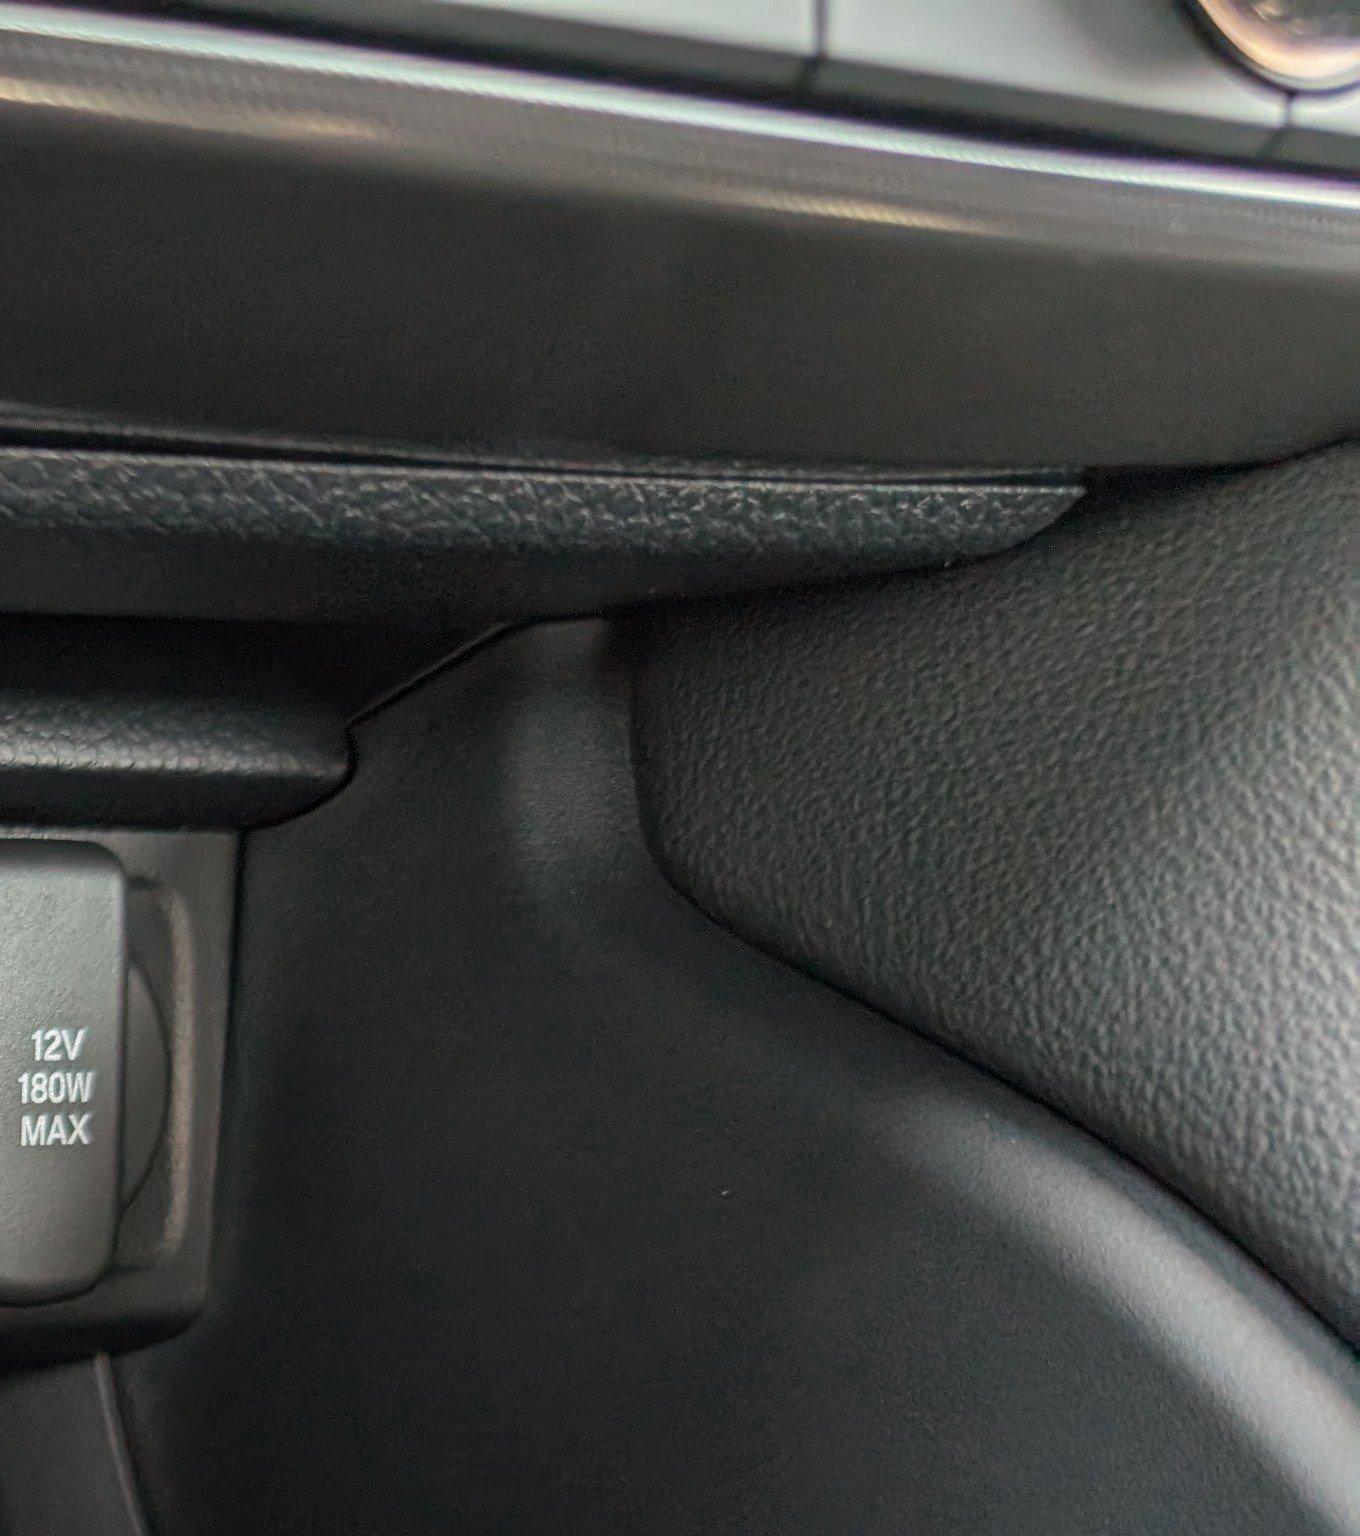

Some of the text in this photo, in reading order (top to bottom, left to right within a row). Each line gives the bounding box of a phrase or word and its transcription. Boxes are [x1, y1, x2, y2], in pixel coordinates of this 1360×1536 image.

[31, 1028, 88, 1061] 12V
[18, 1072, 94, 1104] 180W
[20, 1114, 91, 1146] MAX
